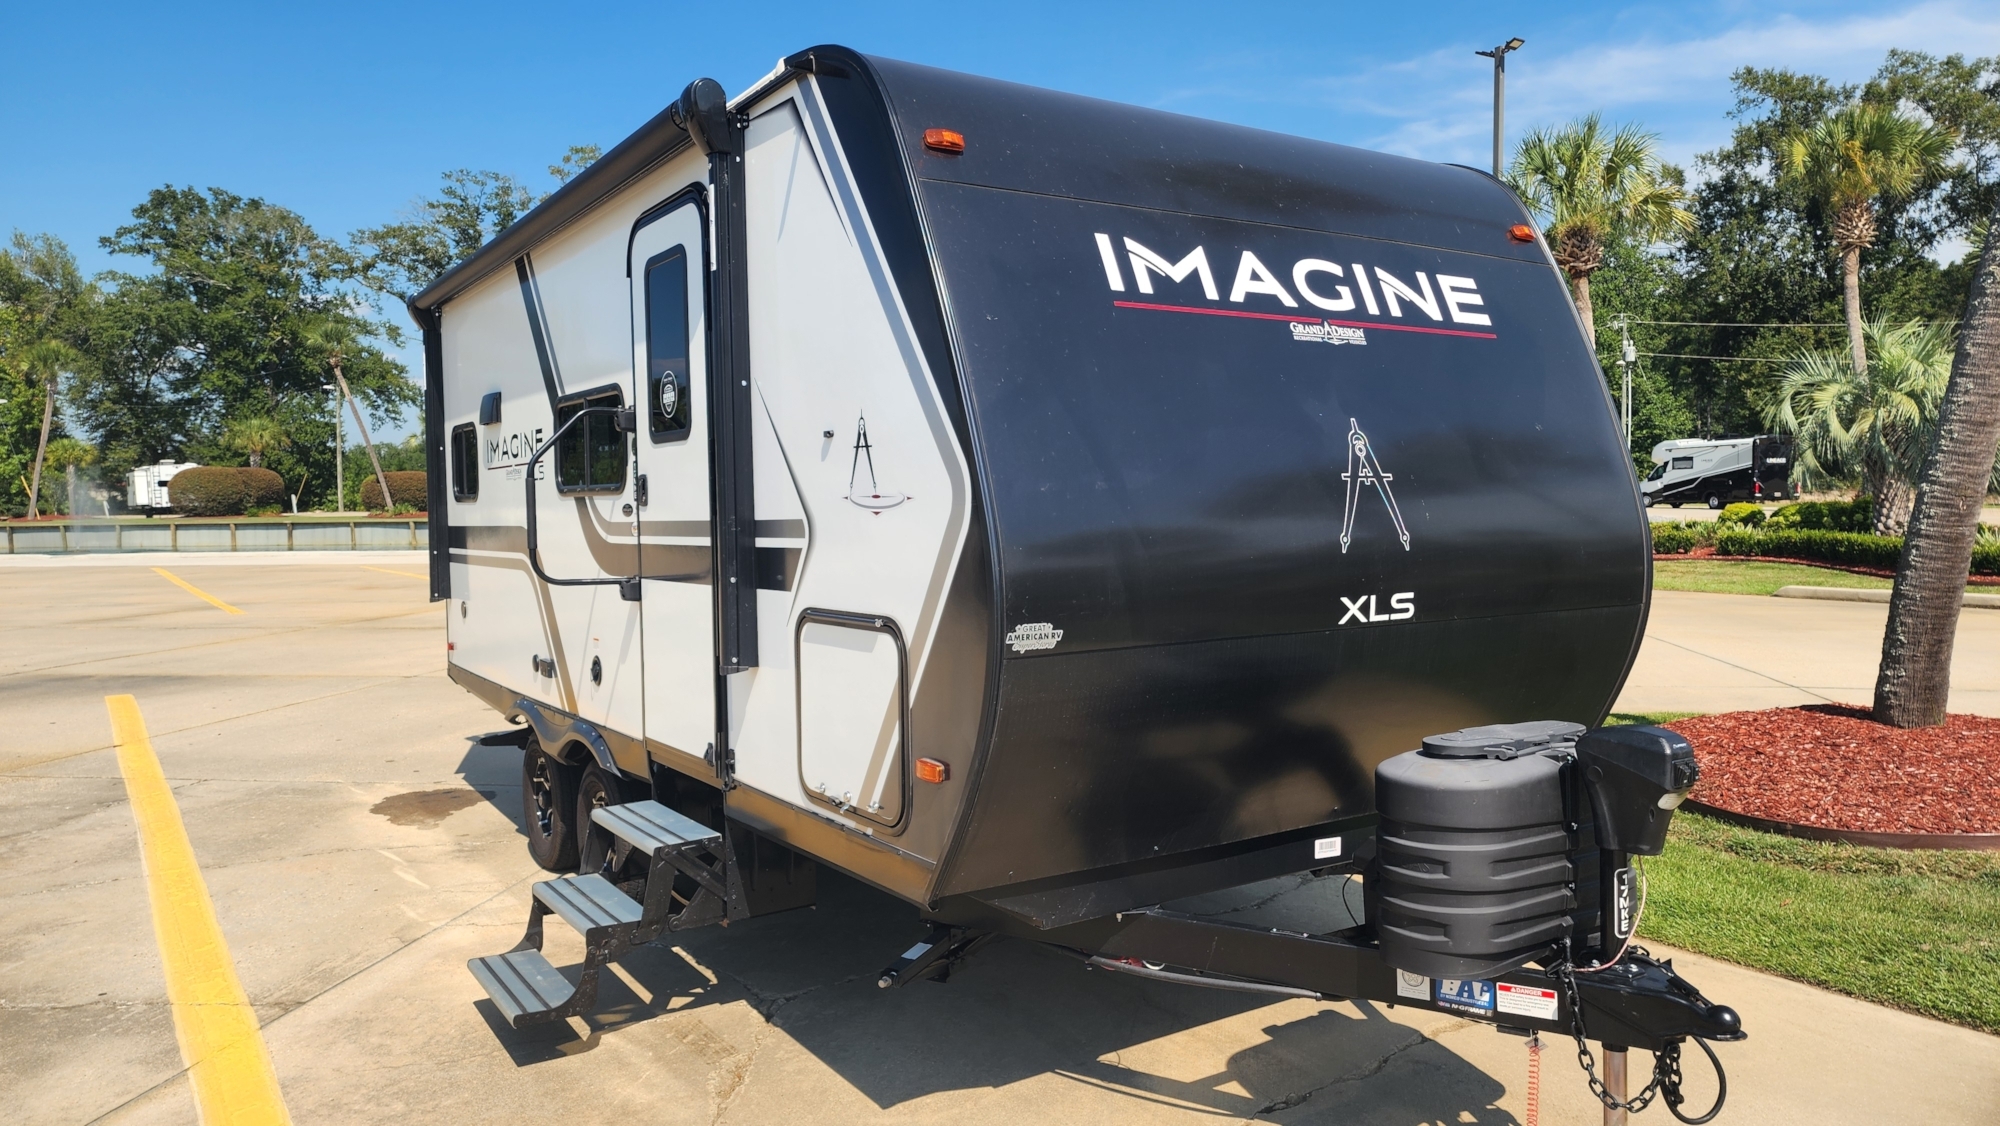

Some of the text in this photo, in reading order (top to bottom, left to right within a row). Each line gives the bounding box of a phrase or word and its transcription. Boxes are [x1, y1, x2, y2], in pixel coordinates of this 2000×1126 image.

[1094, 232, 1492, 326] IMAGINE
[1289, 322, 1365, 338] GRAND DESIGN
[487, 428, 543, 464] IMAGINE
[1337, 591, 1415, 625] XLS
[1007, 631, 1062, 642] AMERICAN RV
[1516, 988, 1543, 997] DANGER
